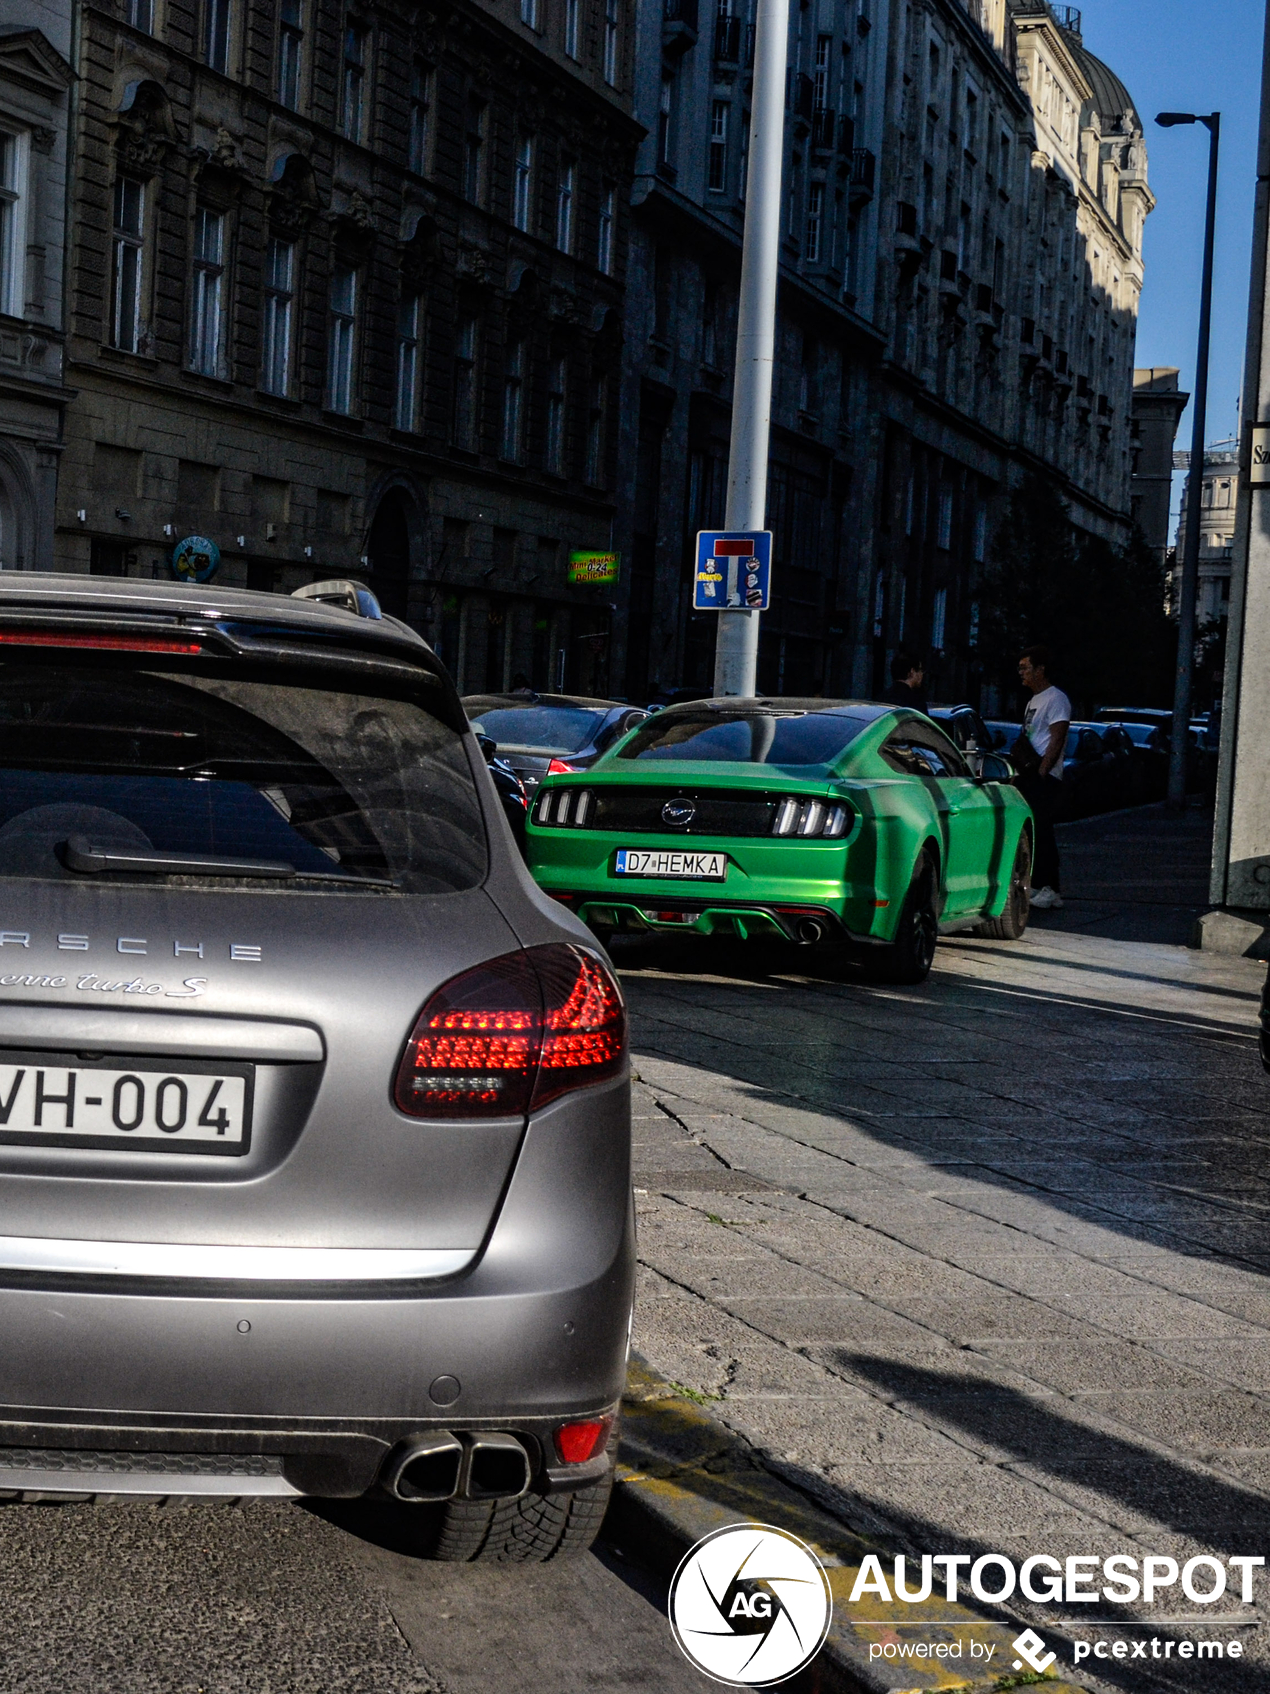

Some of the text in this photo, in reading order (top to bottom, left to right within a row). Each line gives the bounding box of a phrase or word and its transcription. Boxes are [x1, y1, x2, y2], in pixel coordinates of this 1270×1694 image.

[586, 562, 608, 572] 0-24
[627, 853, 720, 875] D7 HEMKA
[76, 972, 163, 996] turbo
[164, 977, 209, 998] S
